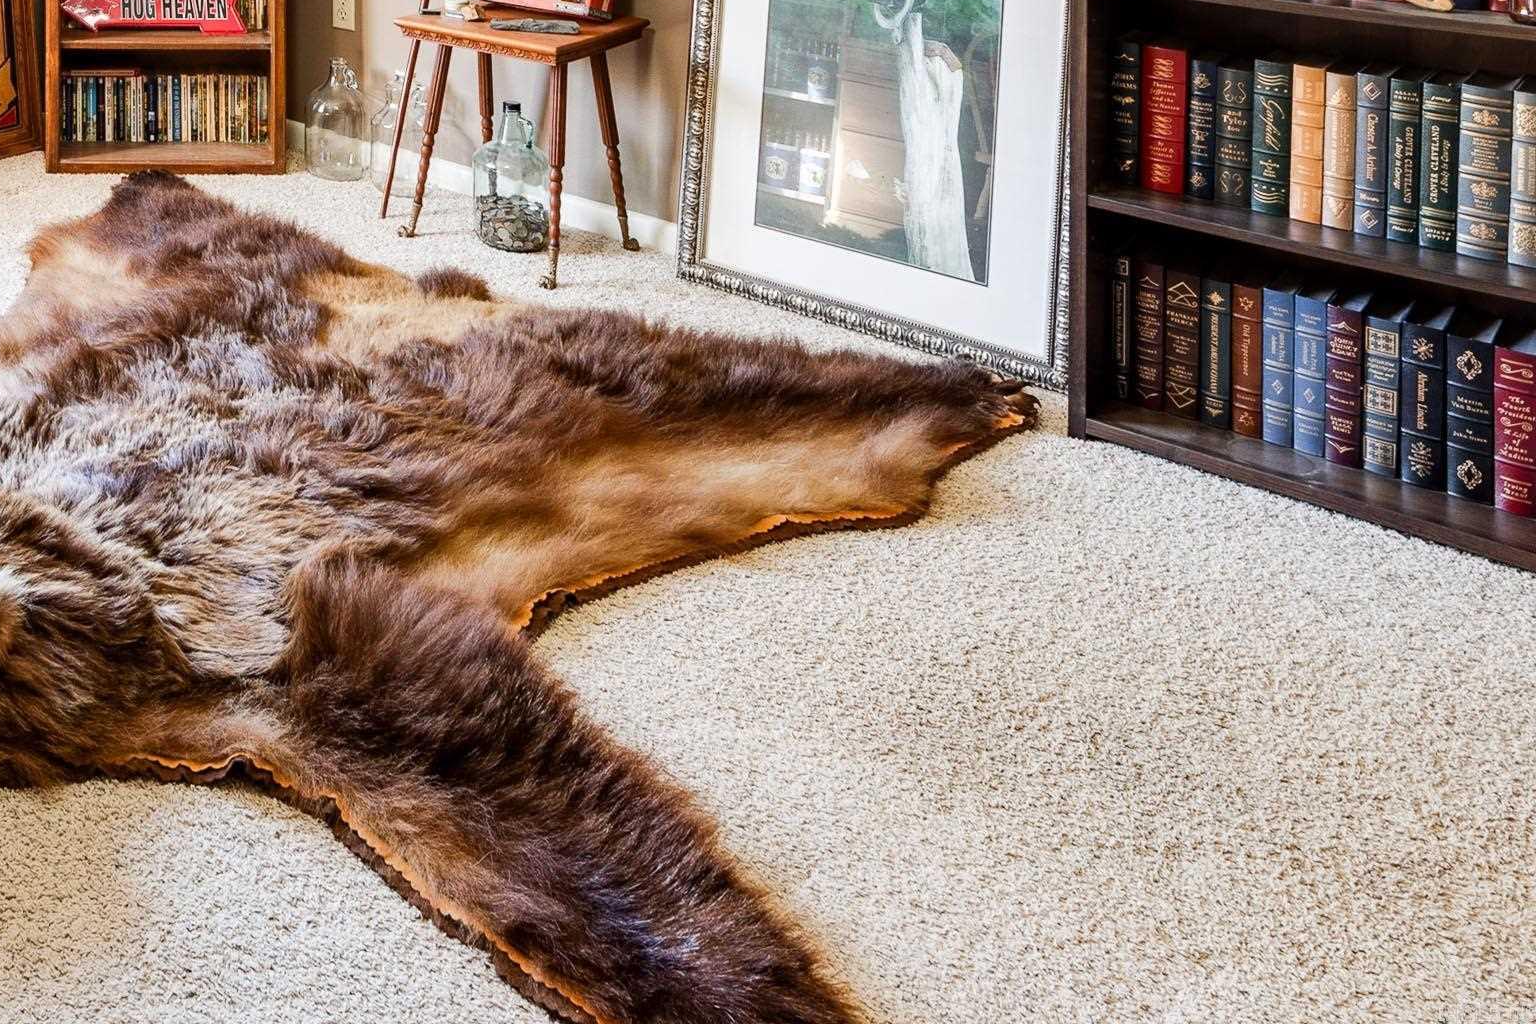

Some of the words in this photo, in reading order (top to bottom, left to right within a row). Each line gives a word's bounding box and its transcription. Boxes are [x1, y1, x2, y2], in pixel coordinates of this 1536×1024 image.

[1221, 115, 1247, 126] Tyler
[1367, 113, 1379, 143] Chester
[1367, 144, 1377, 153] A.
[1405, 127, 1414, 154] GROVER
[1430, 126, 1440, 173] CLEVELAND
[1366, 155, 1377, 181] Arthur
[1404, 157, 1413, 204] CLEVELAND
[1430, 176, 1439, 204] GROVER
[1242, 324, 1250, 337] Old
[1240, 338, 1251, 377] Tippecanoe
[1330, 341, 1358, 353] QUINCY
[1331, 348, 1356, 358] ADAMS
[1417, 371, 1429, 402] Abraham
[1452, 400, 1465, 410] Van
[1466, 404, 1489, 415] Buren
[1456, 394, 1483, 407] Martin
[1416, 403, 1428, 430] Lincoln
